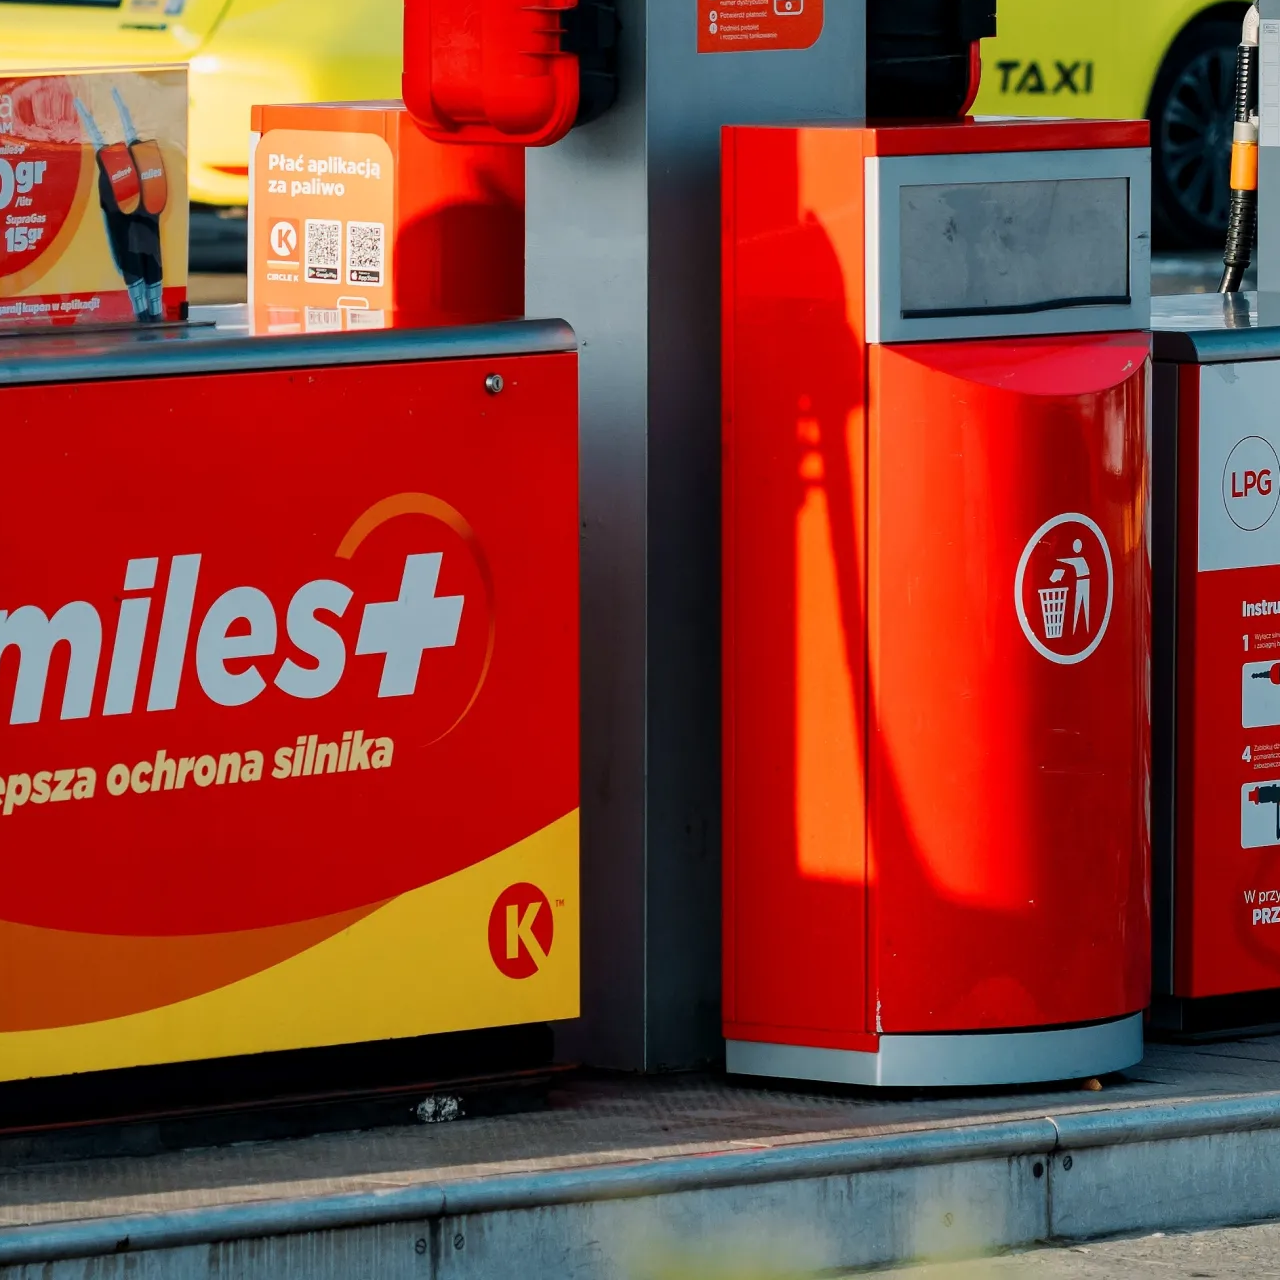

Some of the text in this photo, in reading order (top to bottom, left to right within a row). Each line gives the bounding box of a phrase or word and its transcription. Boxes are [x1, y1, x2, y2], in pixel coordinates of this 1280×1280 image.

[996, 60, 1094, 94] TAXI
[268, 154, 381, 179] Płać aplikacją
[268, 178, 345, 197] za paliwo
[15, 196, 32, 207] /litr
[6, 214, 46, 225] SupraGas
[267, 274, 292, 282] CIRCLE
[21, 302, 50, 313] kupon
[1231, 469, 1272, 498] LPG
[1242, 634, 1248, 651] 1
[106, 744, 263, 796] ochrona
[271, 729, 394, 779] silnika
[1242, 746, 1251, 762] 4
[1244, 890, 1256, 904] W
[505, 901, 548, 970] K
